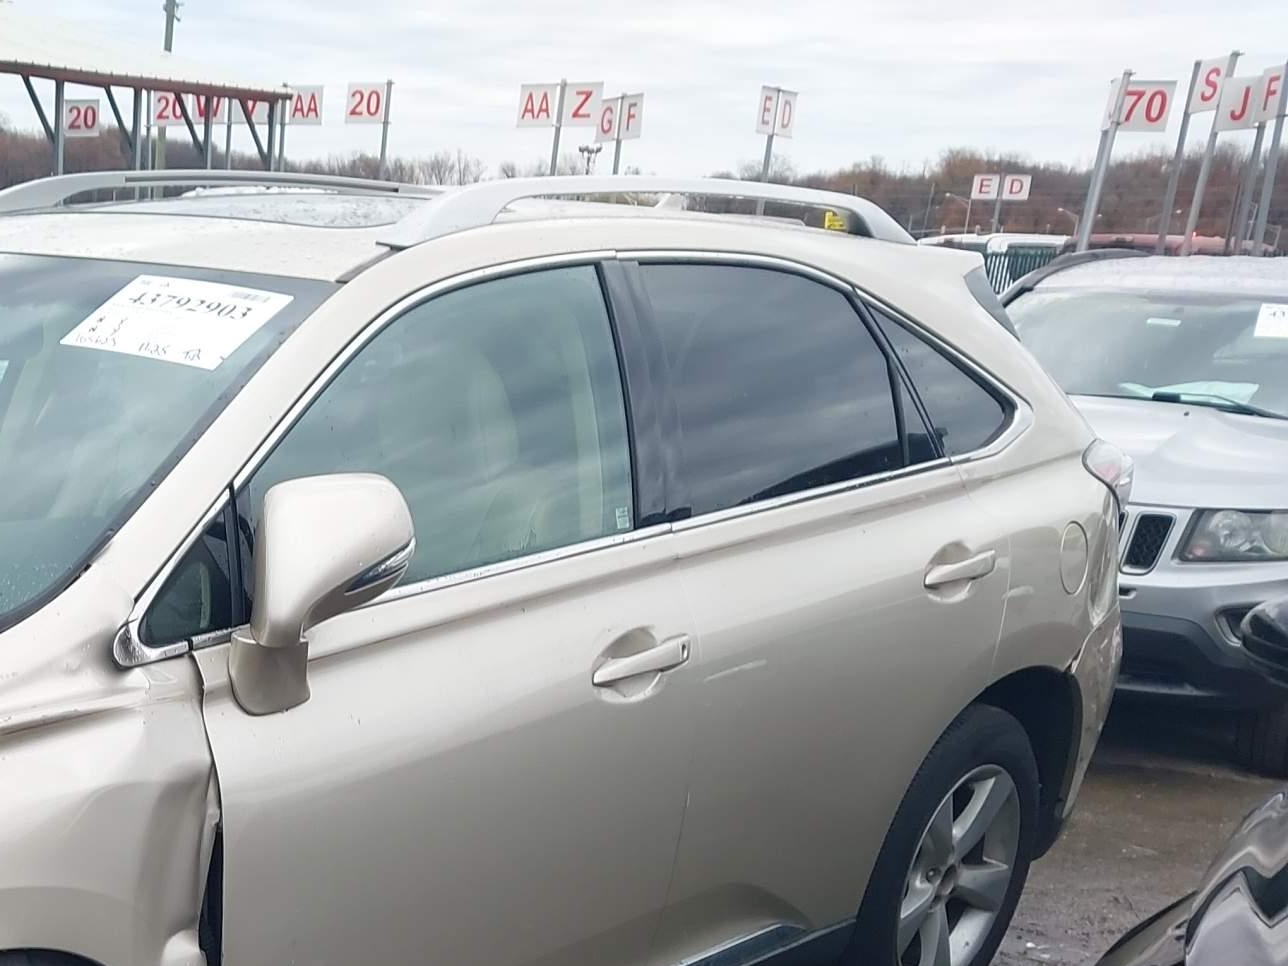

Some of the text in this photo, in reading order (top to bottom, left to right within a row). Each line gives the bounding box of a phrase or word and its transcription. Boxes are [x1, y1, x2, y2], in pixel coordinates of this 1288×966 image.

[1200, 67, 1221, 102] S
[1263, 75, 1281, 112] F
[292, 91, 319, 118] AA
[349, 90, 381, 116] 20
[521, 91, 551, 119] AA
[572, 90, 593, 118] Z
[626, 102, 638, 131] F
[762, 95, 773, 125] E
[781, 99, 792, 128] D
[1124, 90, 1168, 122] 70
[1230, 85, 1251, 121] J
[68, 105, 96, 130] 20
[601, 106, 613, 133] G
[978, 178, 993, 194] E
[1009, 178, 1024, 194] D
